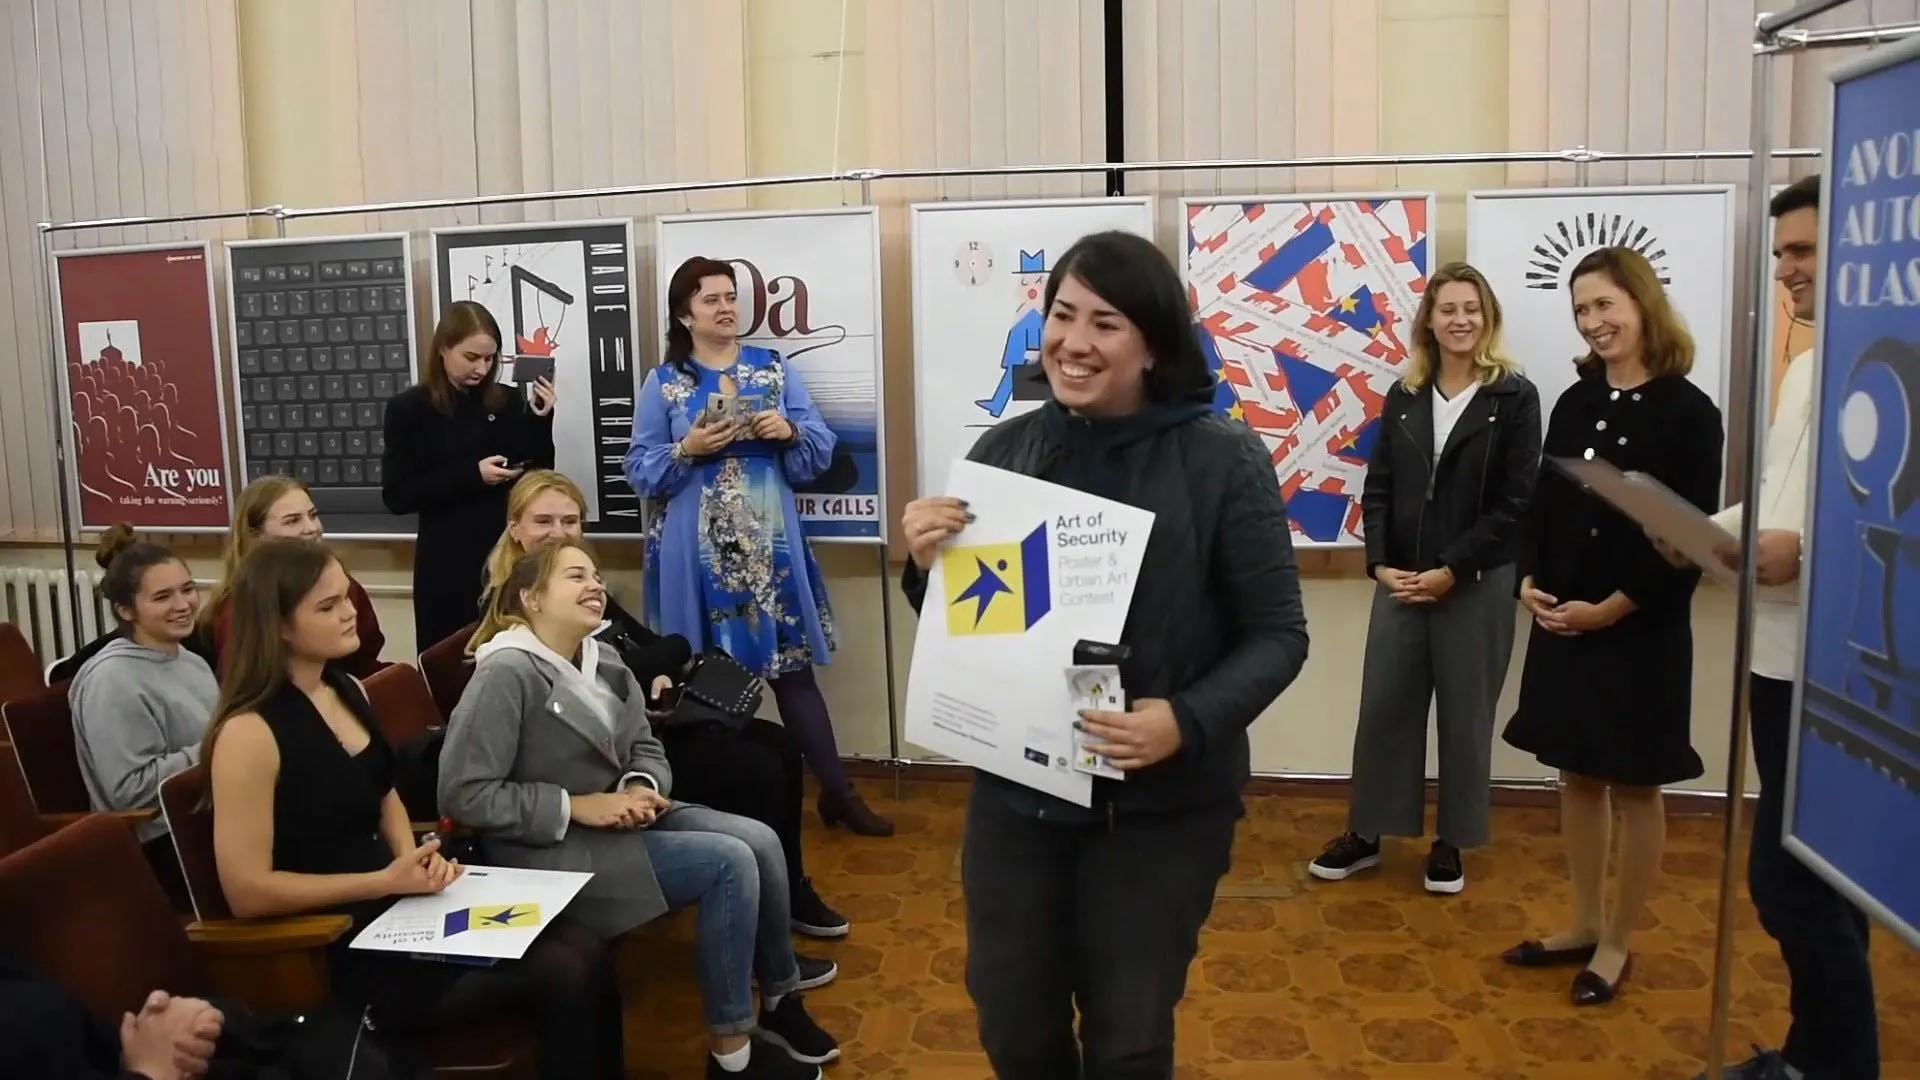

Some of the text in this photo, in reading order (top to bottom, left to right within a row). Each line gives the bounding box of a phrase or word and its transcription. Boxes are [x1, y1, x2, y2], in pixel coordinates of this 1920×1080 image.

[969, 241, 978, 250] 12
[987, 259, 993, 267] 3
[590, 243, 627, 312] MADE
[600, 337, 625, 372] IN
[143, 461, 220, 493] Are you
[120, 495, 142, 506] taking
[144, 496, 156, 504] the
[822, 498, 876, 516] CALLS
[1056, 510, 1104, 530] Art of
[1057, 529, 1128, 547] Security
[1058, 554, 1102, 570] Poster
[1060, 571, 1128, 588] Urban Art
[1060, 590, 1115, 606] Contest
